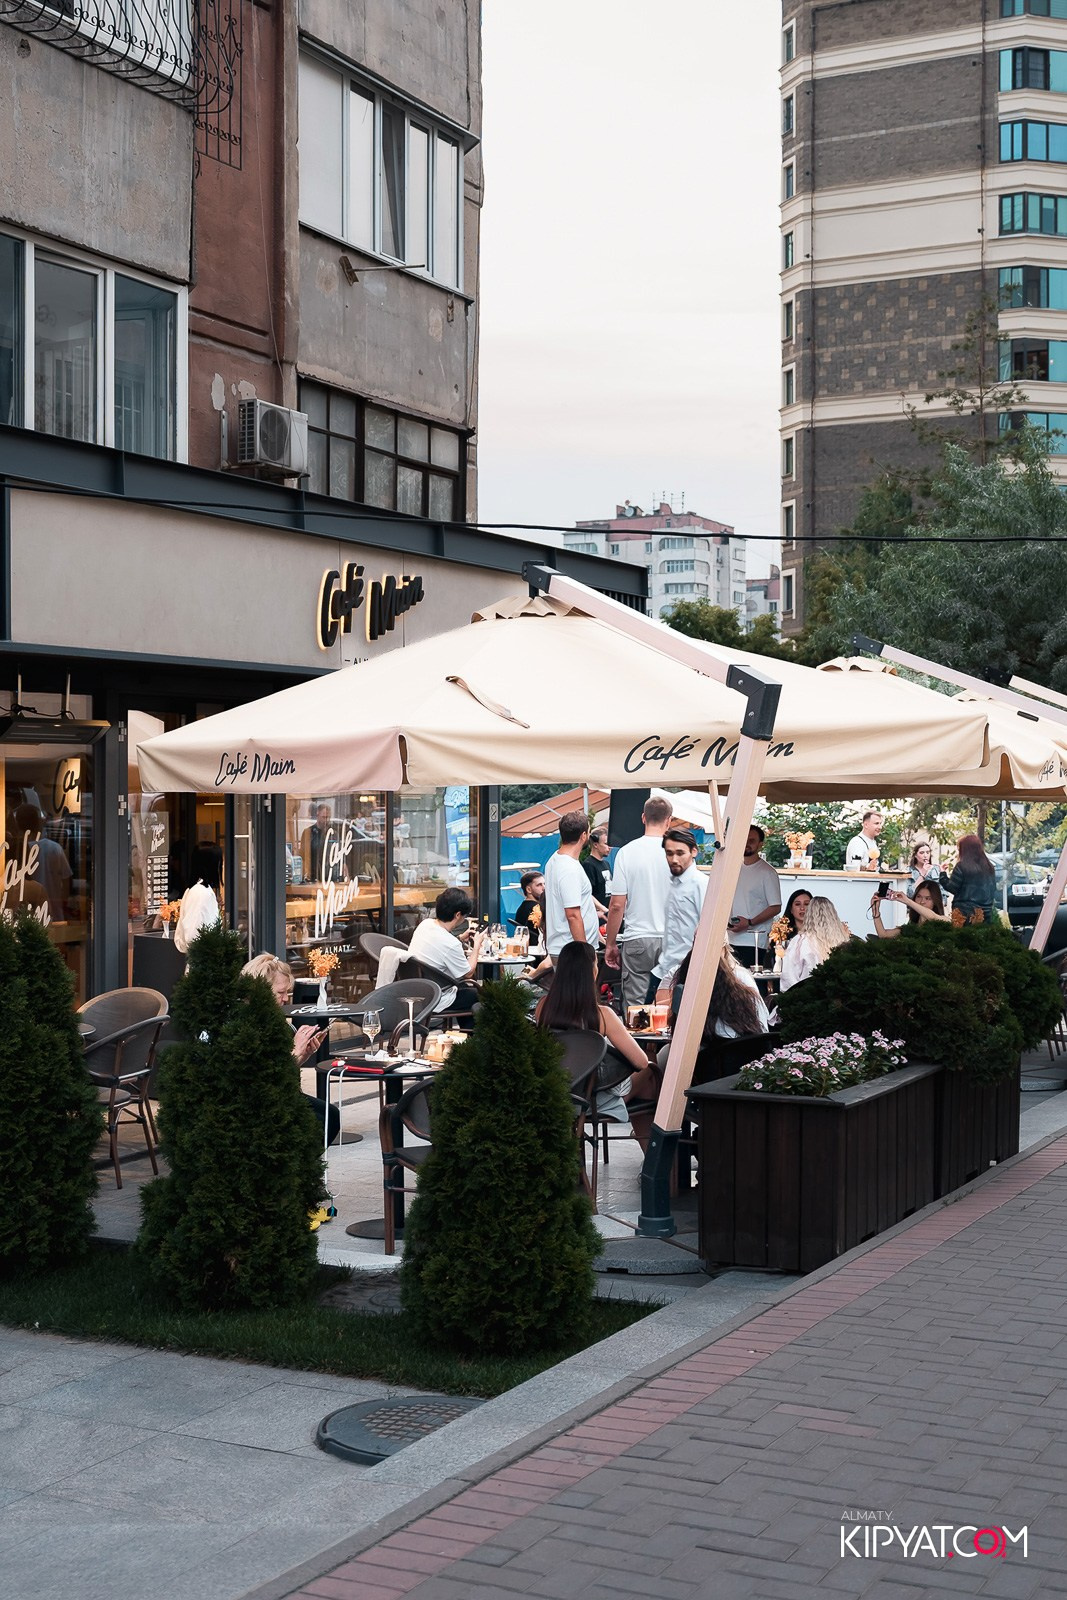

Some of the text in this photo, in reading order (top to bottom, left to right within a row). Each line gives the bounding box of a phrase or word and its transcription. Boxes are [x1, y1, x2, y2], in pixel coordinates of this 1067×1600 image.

[318, 561, 425, 648] Café Main
[215, 752, 296, 786] Café Main
[624, 735, 794, 773] Café Mn
[322, 819, 353, 889] Café
[315, 876, 360, 939] Main
[325, 944, 350, 955] ALMATY
